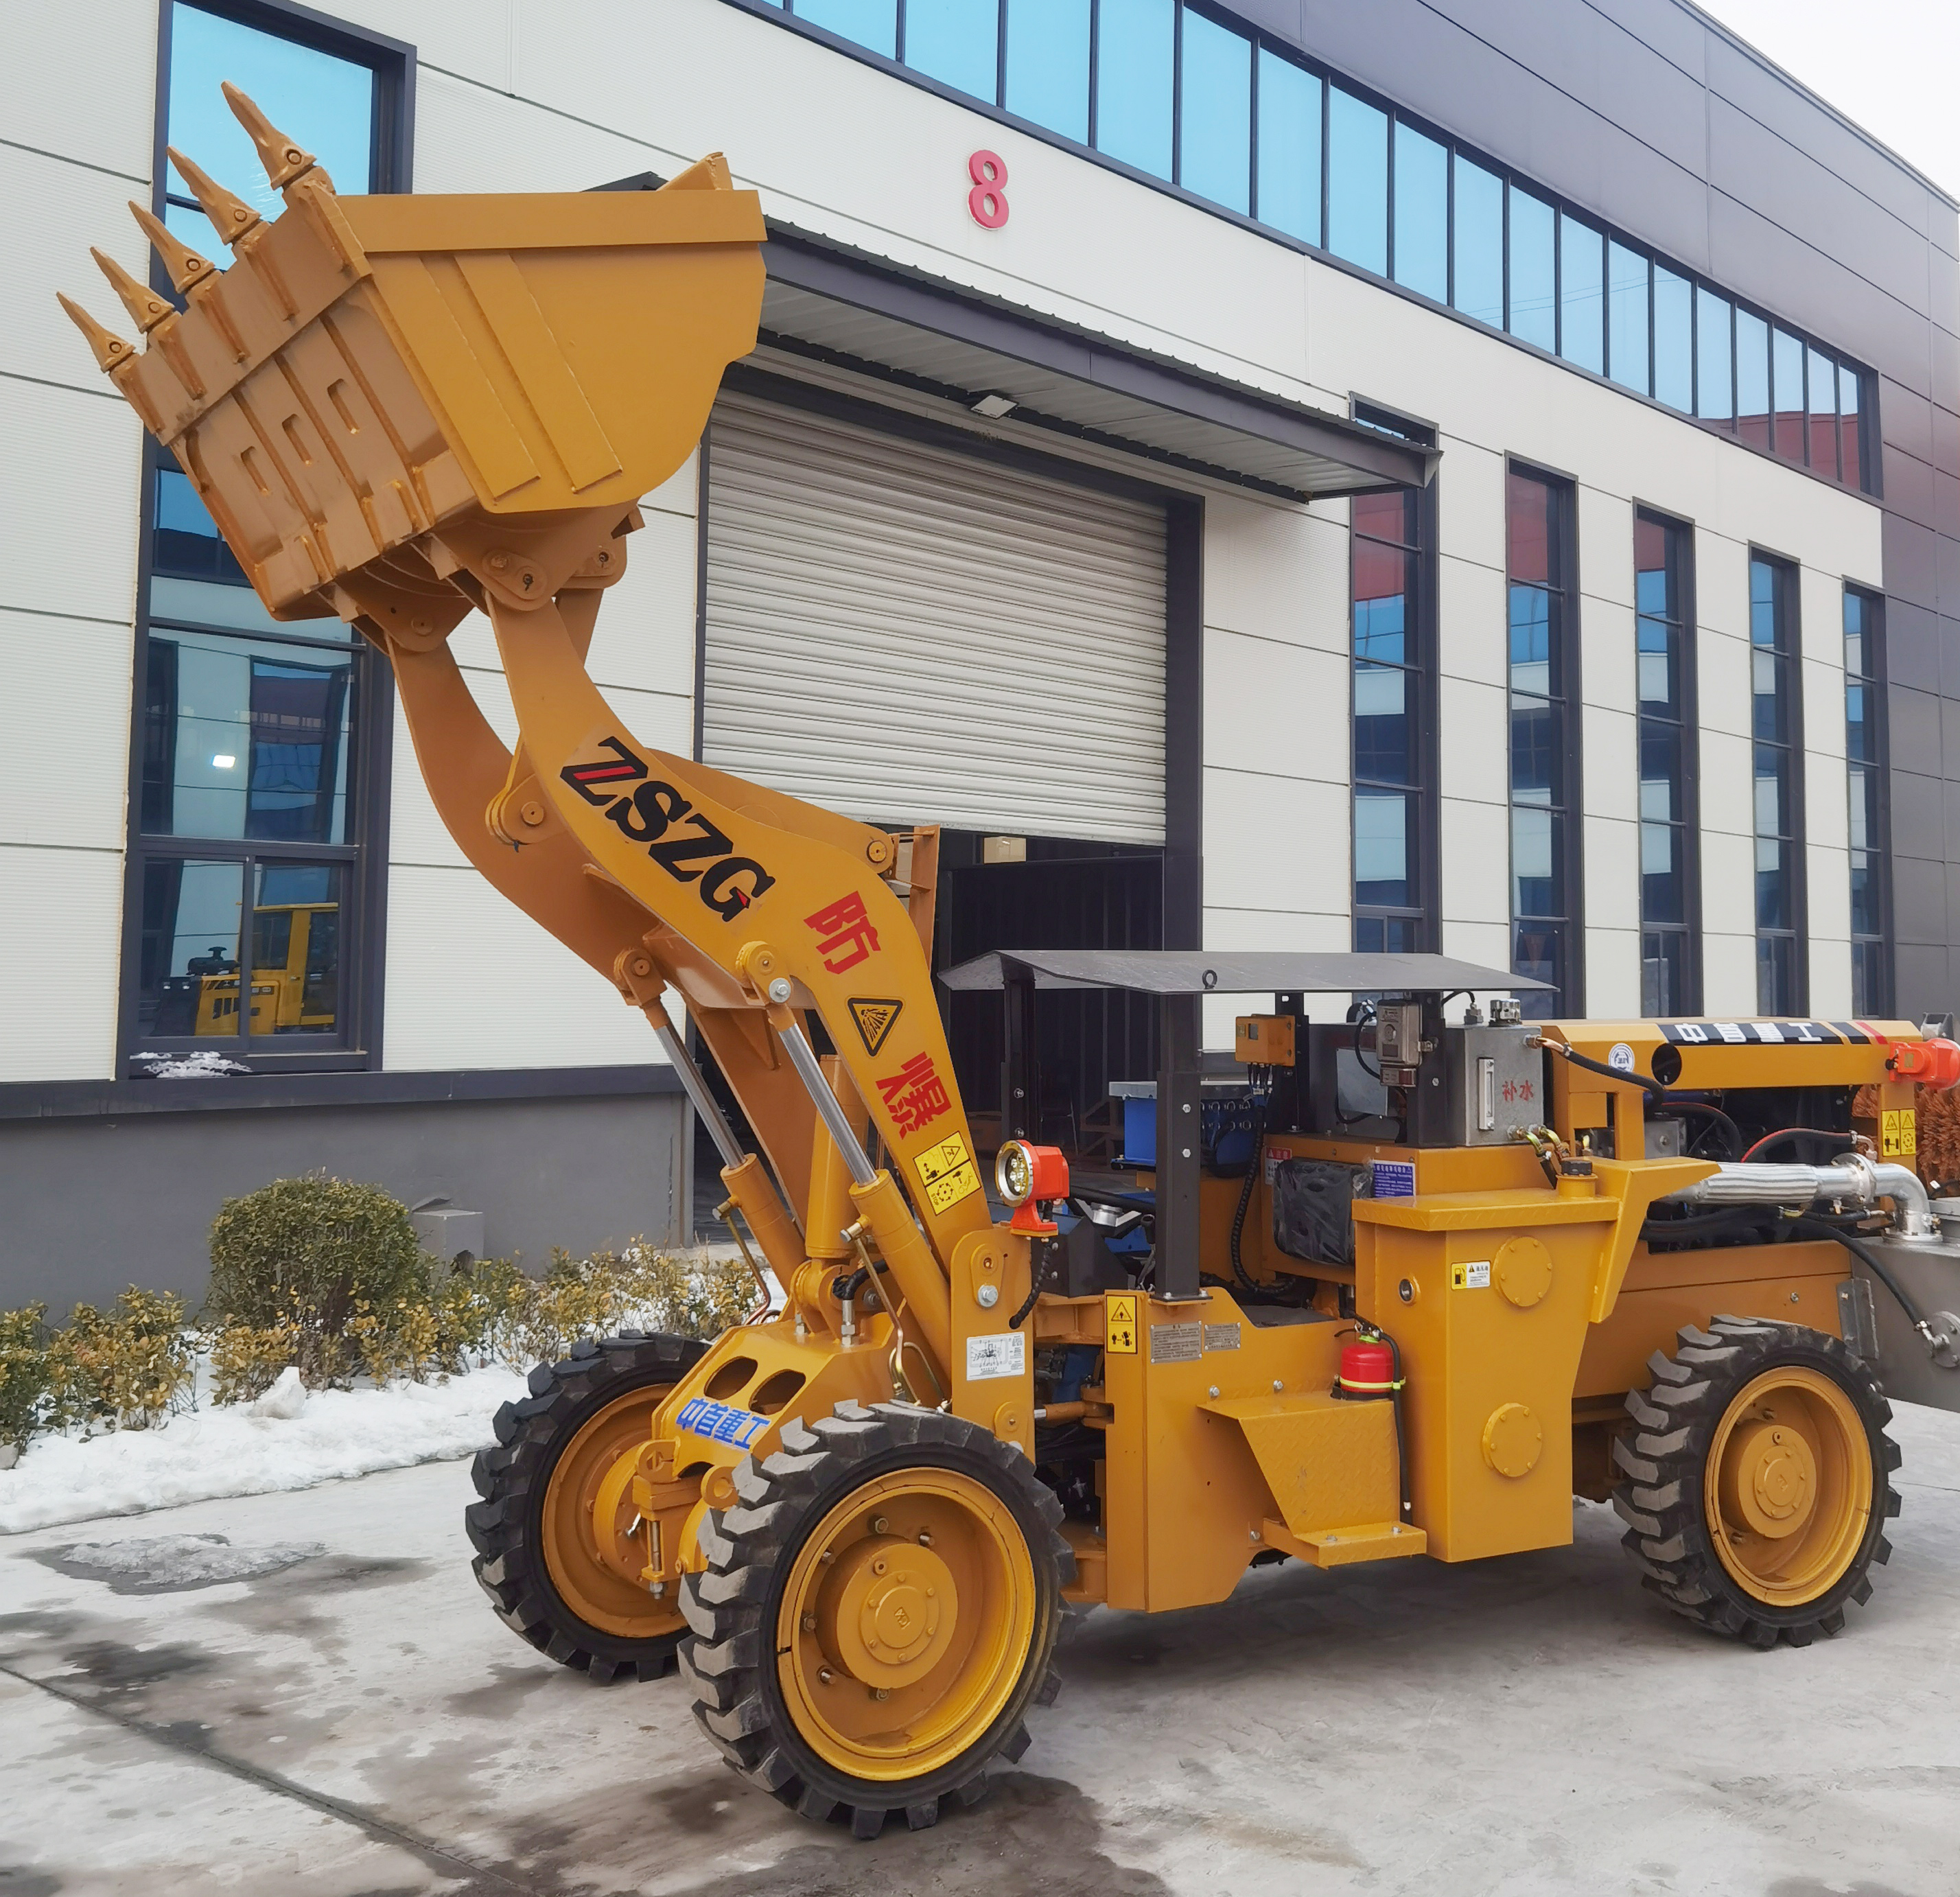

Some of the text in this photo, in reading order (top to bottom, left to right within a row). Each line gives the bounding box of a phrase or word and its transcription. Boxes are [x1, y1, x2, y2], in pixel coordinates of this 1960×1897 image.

[968, 149, 1010, 229] 8
[560, 736, 776, 922] ZSZG
[803, 890, 952, 1140] 防 爆
[1502, 1080, 1535, 1102] 补水
[676, 1398, 771, 1450] 中首重工
